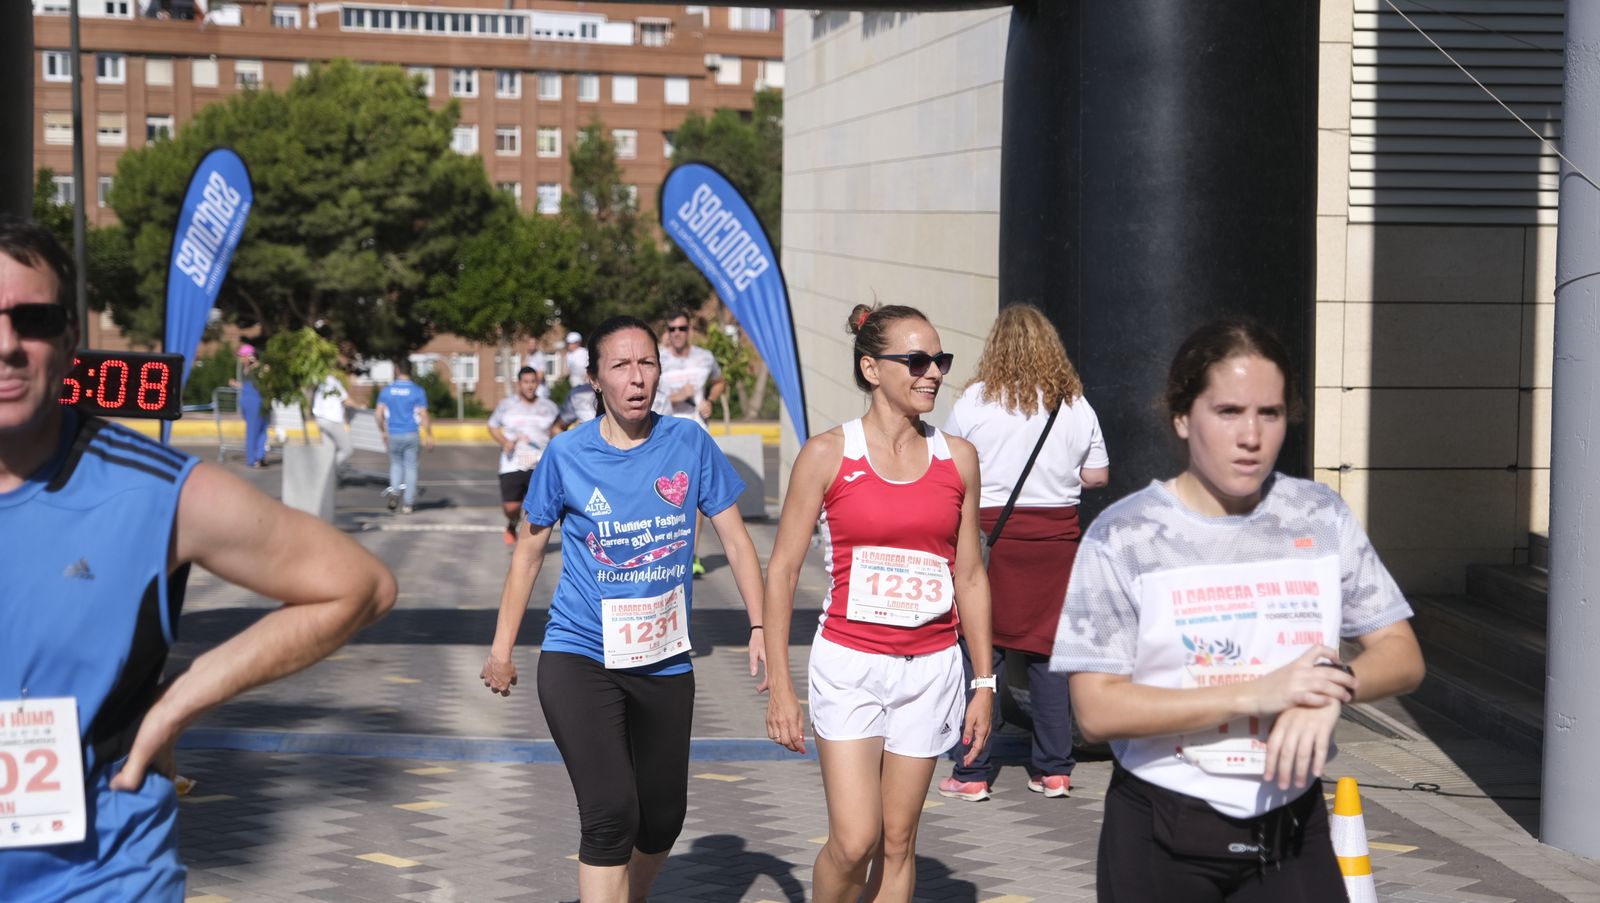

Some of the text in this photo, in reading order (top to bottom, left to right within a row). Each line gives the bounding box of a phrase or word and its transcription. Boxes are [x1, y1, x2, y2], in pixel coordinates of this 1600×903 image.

[584, 502, 611, 512] ALTEA
[598, 513, 686, 538] II Runner Fashion
[600, 537, 629, 548] Carrera
[631, 529, 655, 550] azul
[866, 572, 943, 603] 1233
[1172, 591, 1182, 605] II
[1186, 585, 1253, 603] CARRERA
[1255, 582, 1281, 597] SIN
[619, 610, 678, 645] 1231
[1277, 631, 1285, 645] 4
